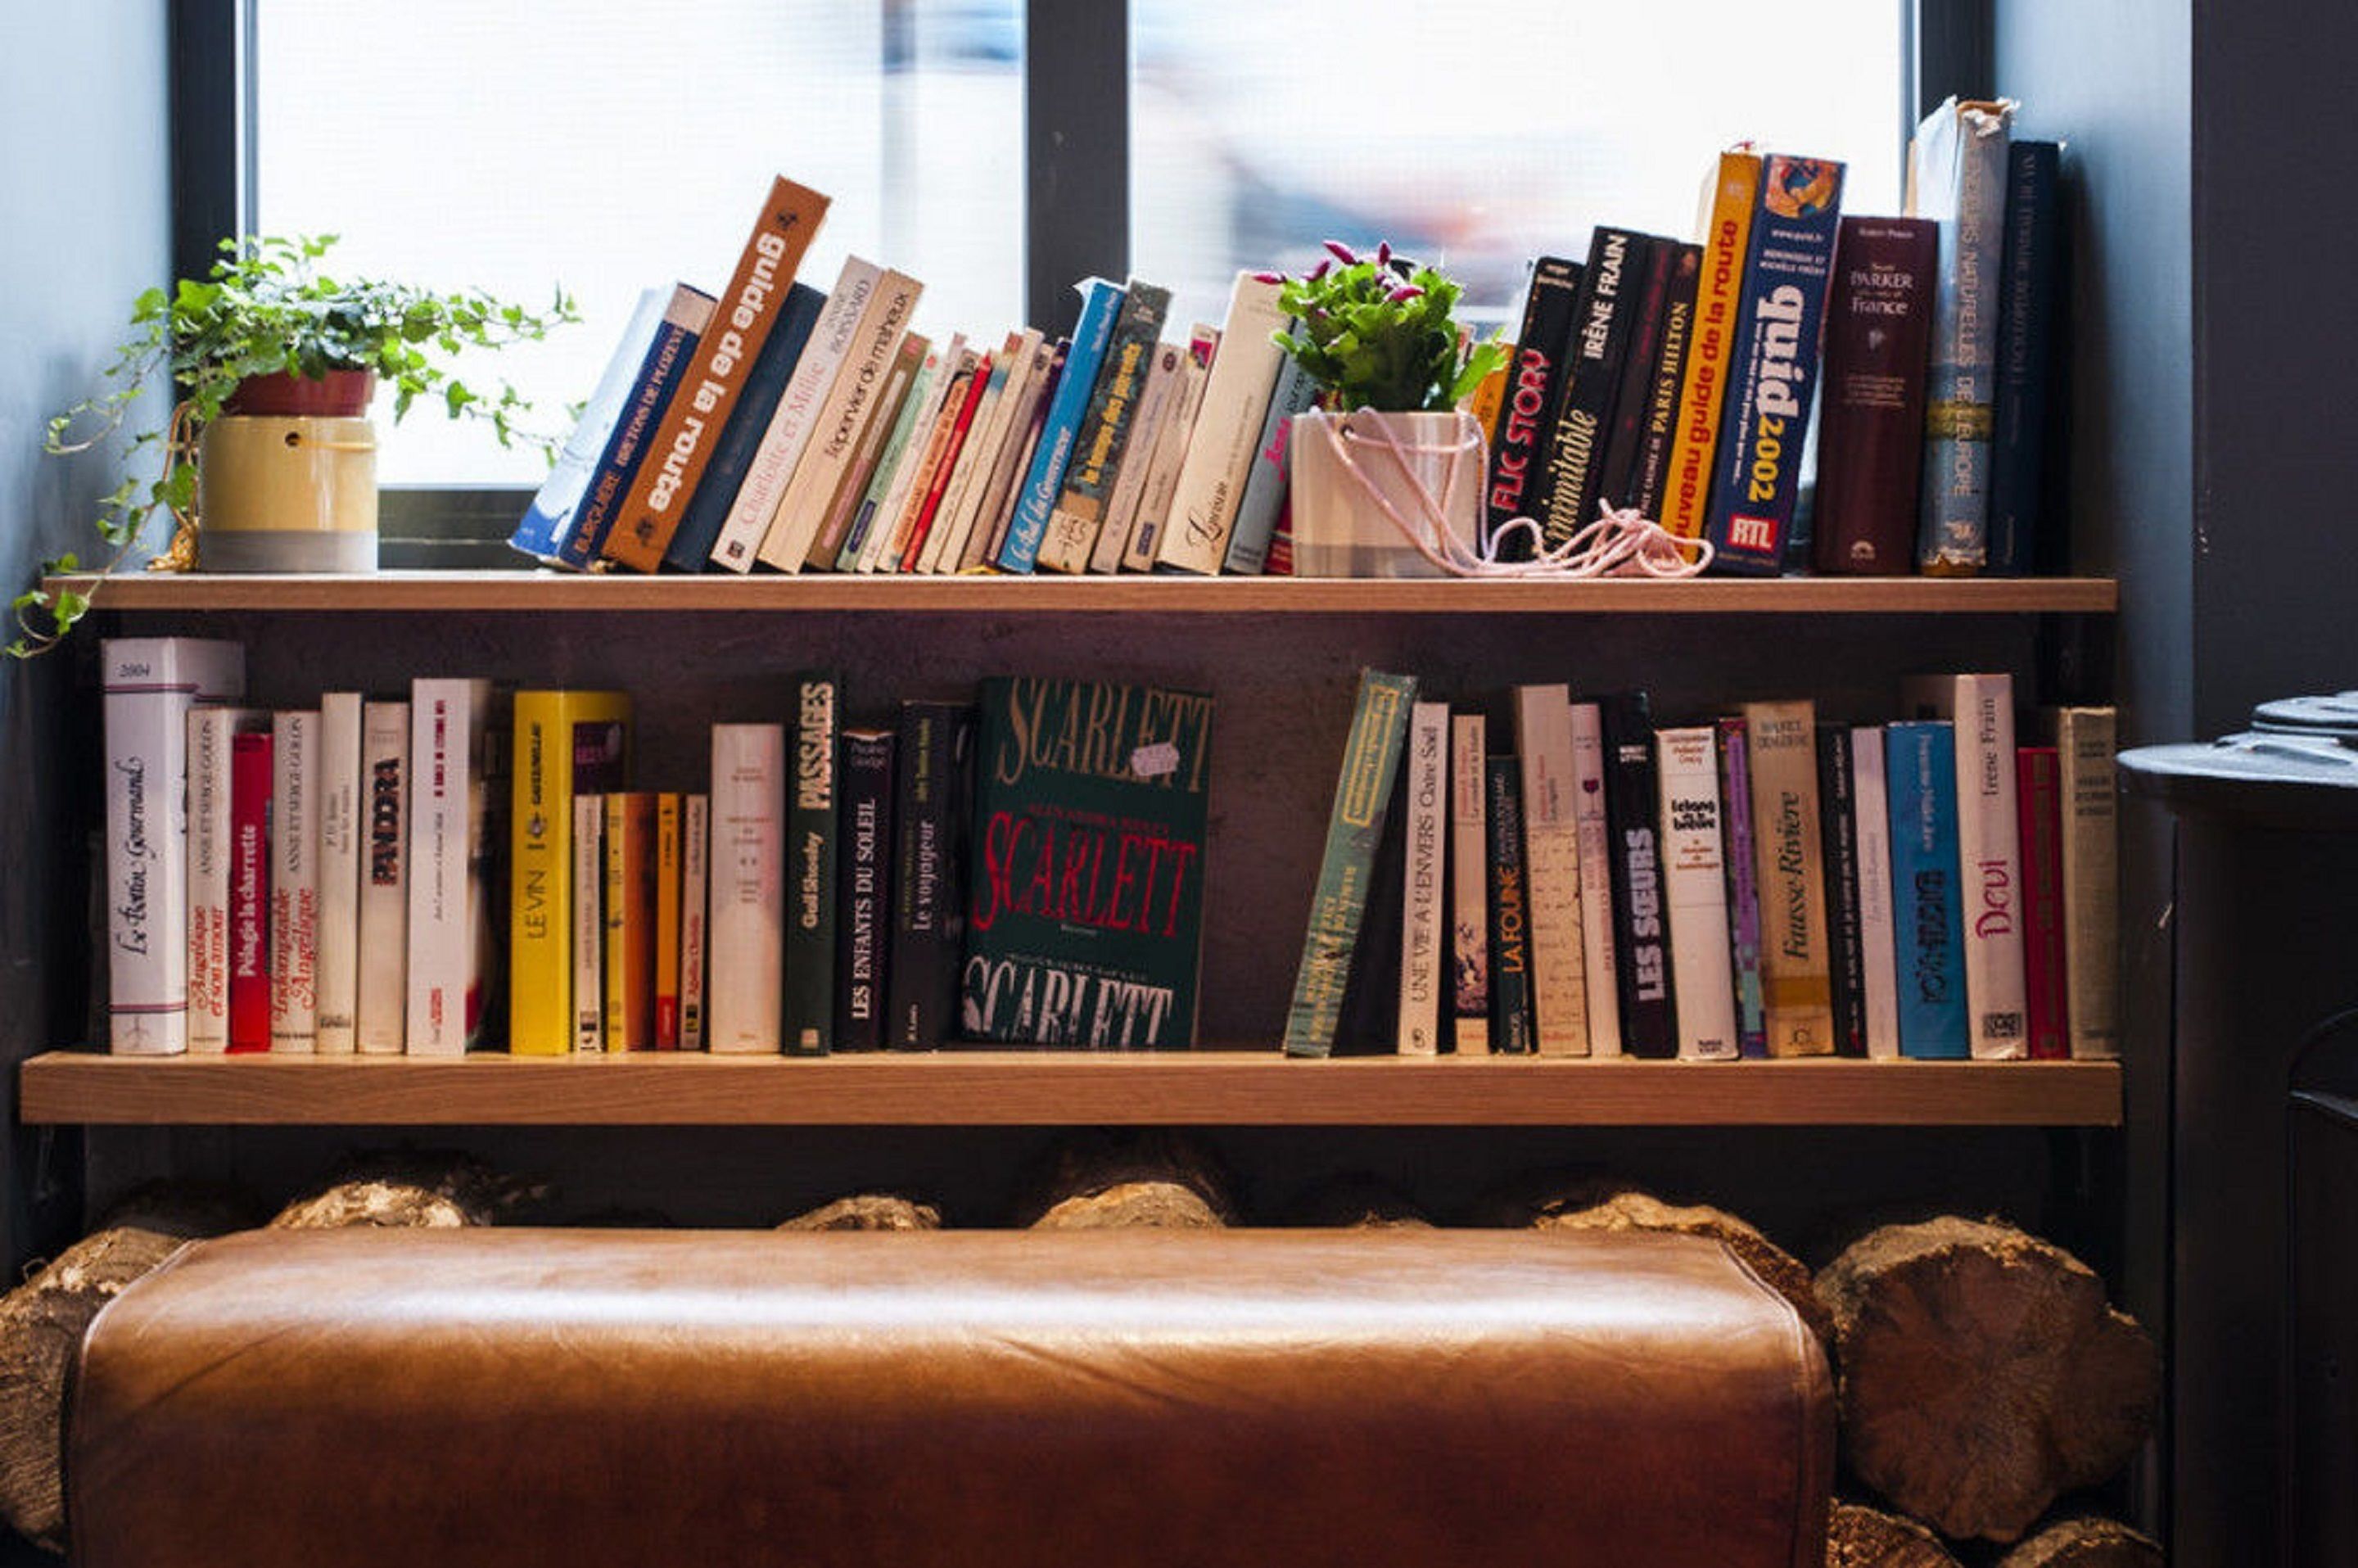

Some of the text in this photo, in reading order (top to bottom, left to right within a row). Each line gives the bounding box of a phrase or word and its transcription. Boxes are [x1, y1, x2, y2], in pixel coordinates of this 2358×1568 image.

[1597, 234, 1626, 296] FRAIN
[1850, 270, 1913, 288] PARKER
[1851, 296, 1909, 315] France
[1956, 251, 1980, 367] NATURELLES
[648, 234, 787, 513] guide de la route
[1651, 377, 1673, 433] PARIS
[1662, 301, 1687, 373] HILTON
[1674, 219, 1737, 554] uveau guide de la route
[1747, 284, 1803, 504] quid 2002
[1955, 376, 1975, 401] DE
[1493, 347, 1550, 512] FLIC STORY
[1731, 517, 1773, 550] RTL
[798, 680, 833, 810] PASSAGES
[996, 677, 1213, 793] SCARLETT
[1977, 697, 1995, 744] Frain
[115, 755, 156, 856] Gourmand
[371, 756, 399, 884] PANDORA
[801, 891, 819, 929] Gail
[852, 798, 876, 1018] LES ENFANTS DU SOLEIL
[911, 819, 940, 930] Le voyageur
[972, 810, 1197, 938] SCARLETT
[1495, 865, 1523, 942] FOUINE
[1625, 826, 1665, 1001] LES SŒURS
[1773, 790, 1809, 962] Fausse-Rivière
[1411, 961, 1430, 1002] UNE
[1413, 929, 1430, 958] VIE
[1500, 943, 1524, 974] LA
[964, 956, 1174, 1049] SCARLETT
